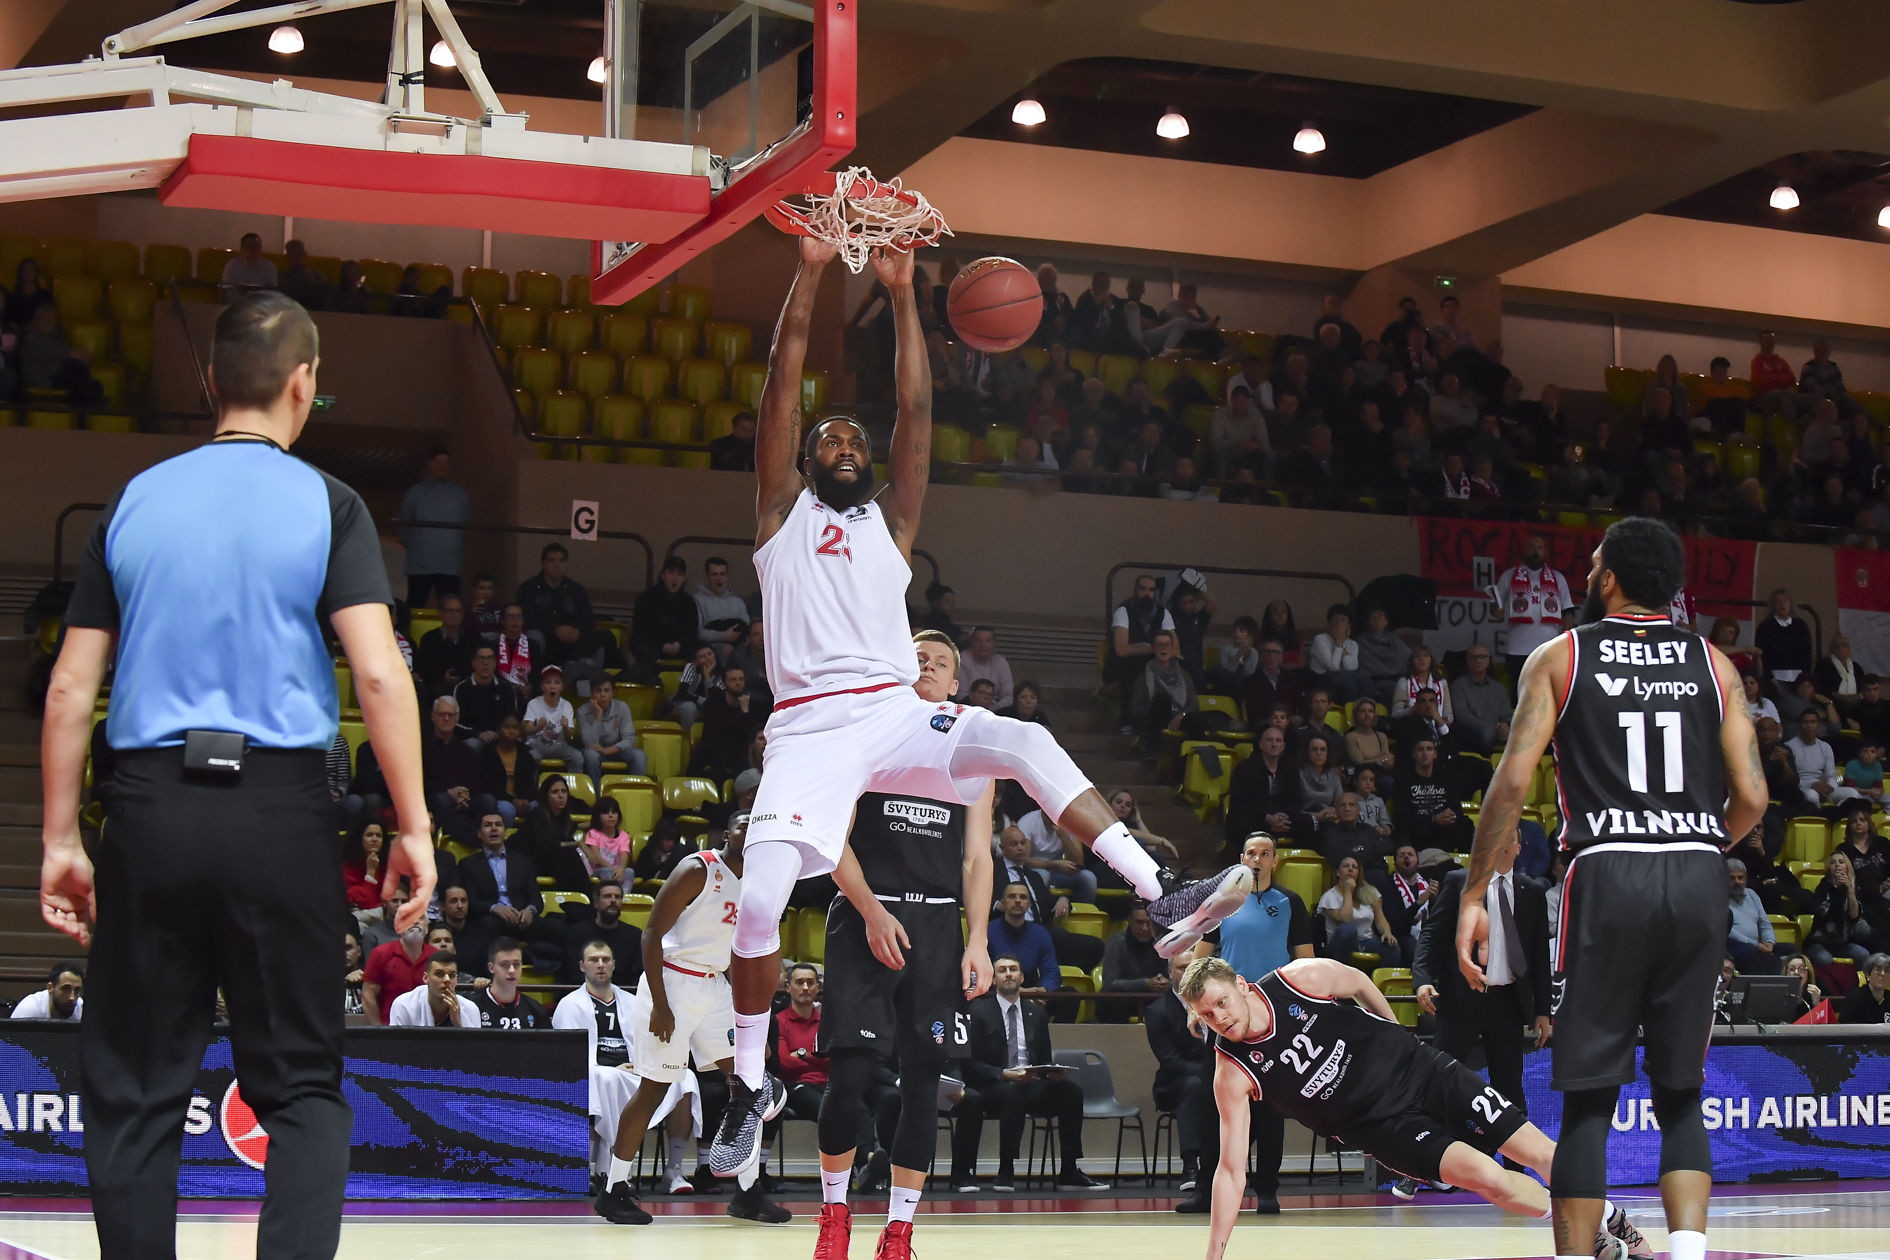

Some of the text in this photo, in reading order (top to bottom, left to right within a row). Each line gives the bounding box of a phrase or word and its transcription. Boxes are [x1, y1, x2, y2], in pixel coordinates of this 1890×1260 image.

[574, 506, 596, 534] G
[1476, 562, 1492, 587] H
[1599, 639, 1687, 666] SEELEY
[1633, 676, 1699, 701] Lympo
[1618, 711, 1684, 794] 11
[752, 813, 778, 825] OREZZA
[887, 801, 947, 821] ŠVYTURYS
[1585, 808, 1725, 838] VILNIUS
[889, 821, 907, 832] GO
[500, 1017, 521, 1030] 23
[605, 1012, 616, 1031] 7
[954, 1012, 972, 1045] 5
[1280, 1033, 1324, 1075] 22
[1320, 1087, 1334, 1100] GO
[1471, 1086, 1513, 1124] 22
